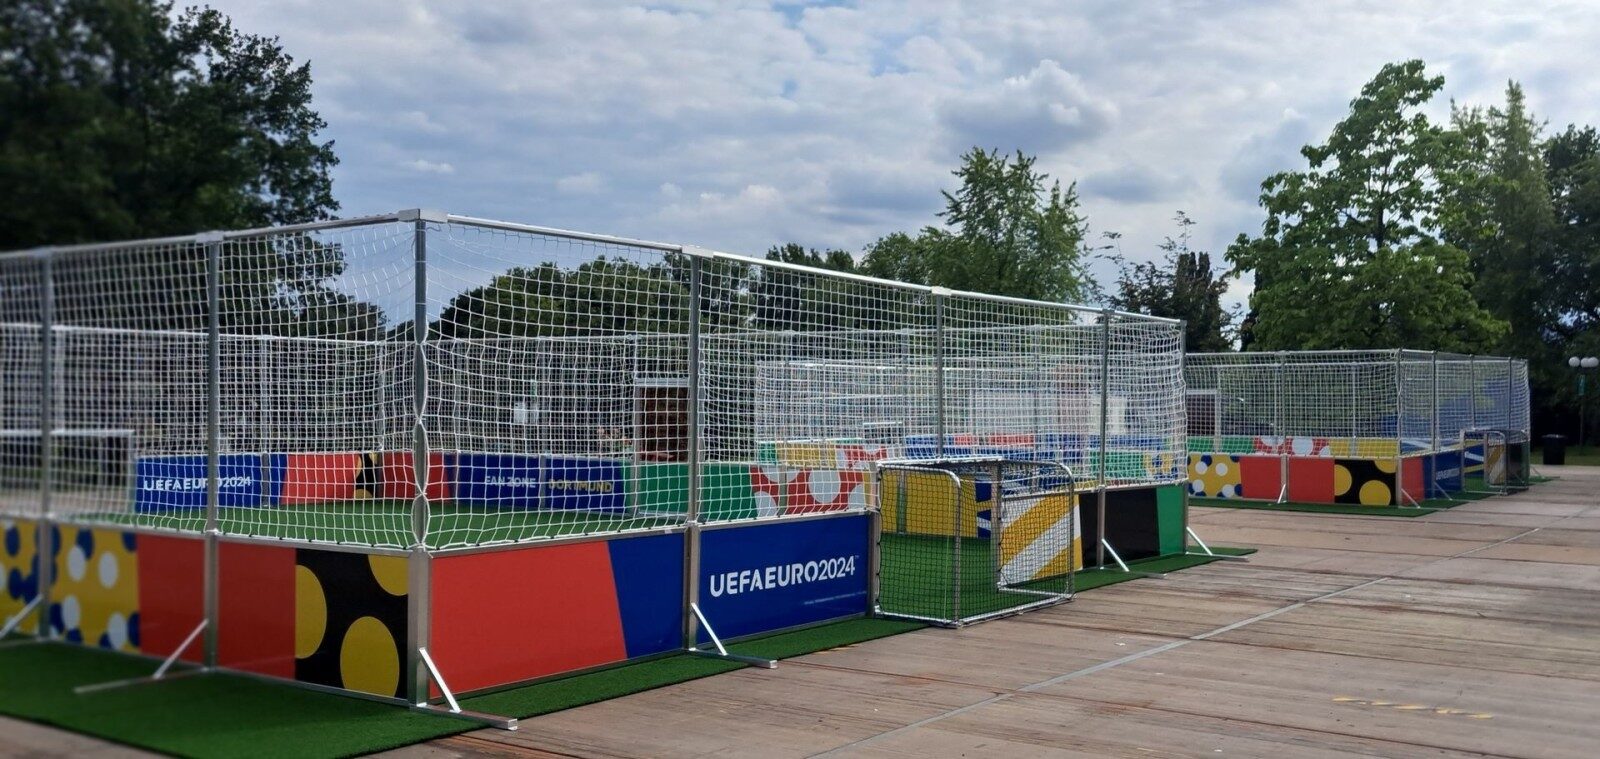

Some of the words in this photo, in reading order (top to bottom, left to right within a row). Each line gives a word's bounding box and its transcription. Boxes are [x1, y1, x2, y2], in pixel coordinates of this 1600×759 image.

[485, 476, 505, 486] FAN
[507, 477, 536, 488] ZONE
[548, 479, 614, 493] DORTMUND
